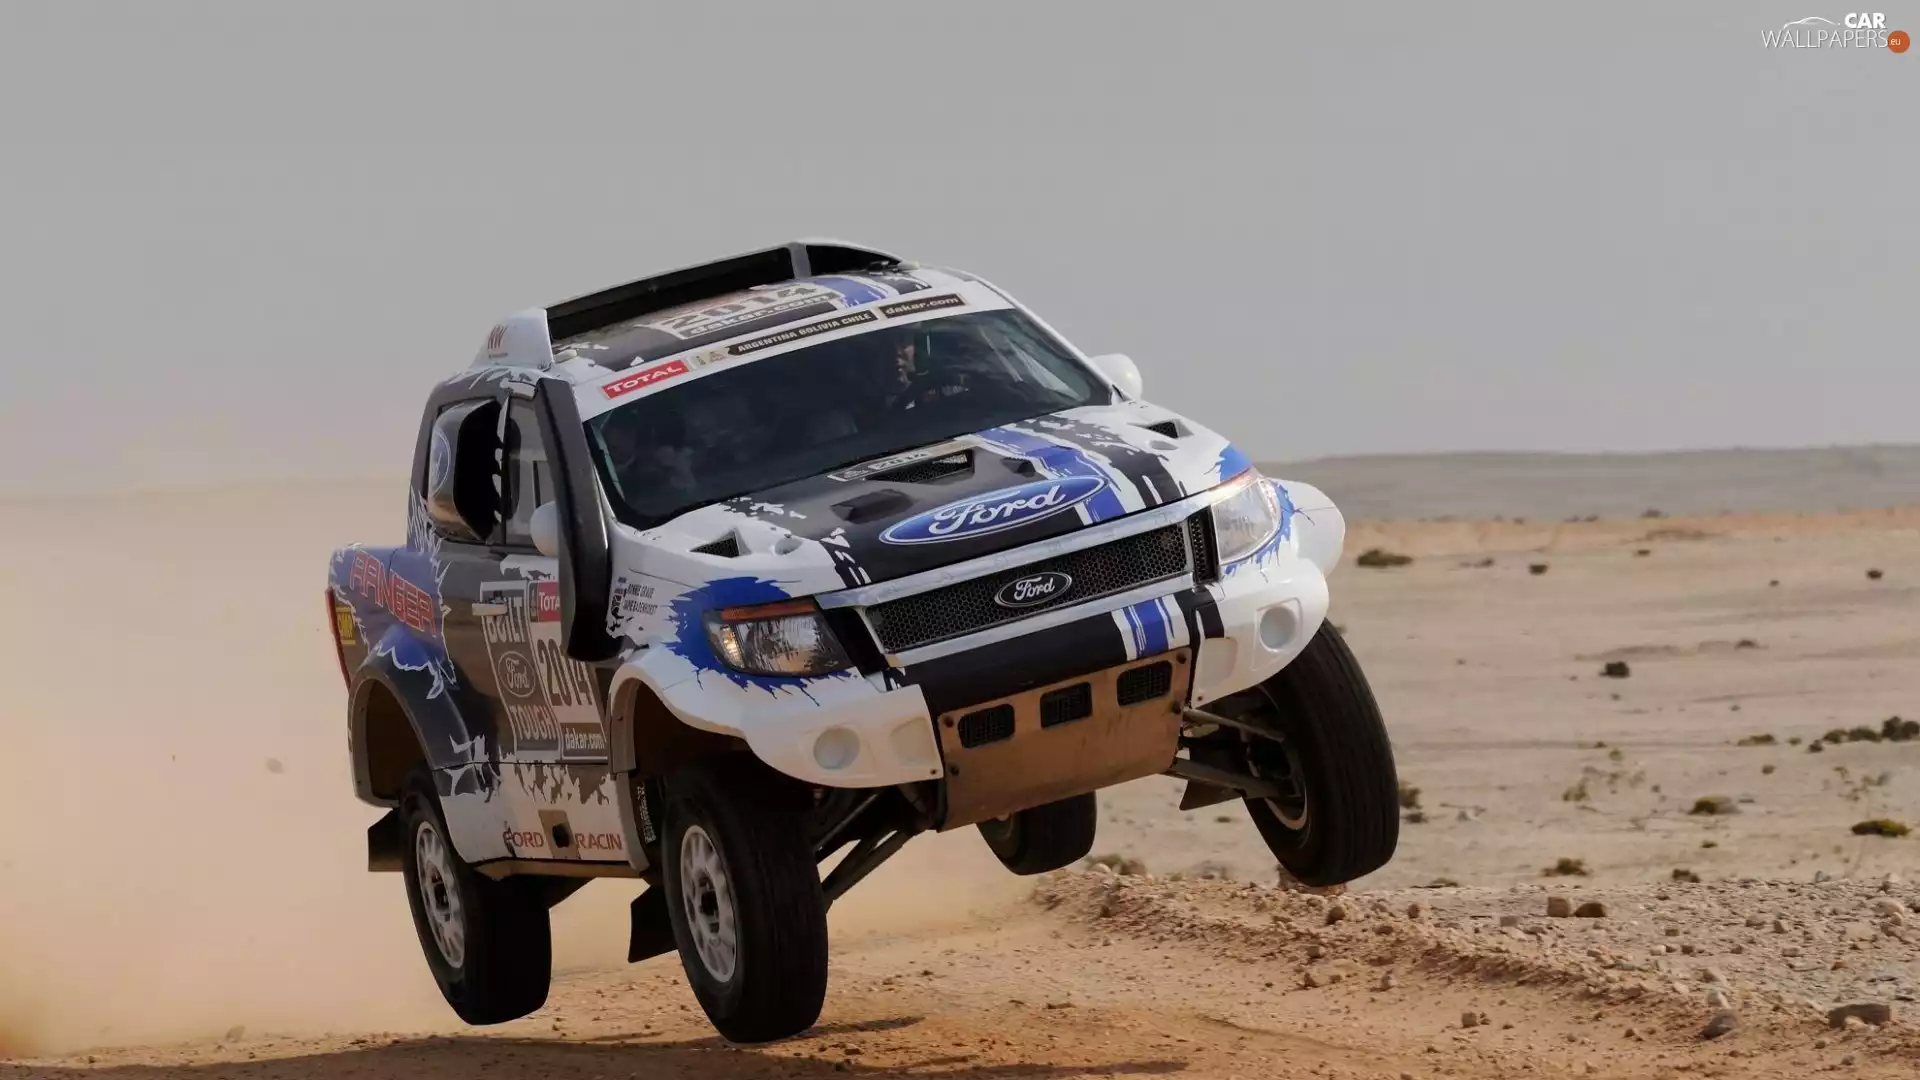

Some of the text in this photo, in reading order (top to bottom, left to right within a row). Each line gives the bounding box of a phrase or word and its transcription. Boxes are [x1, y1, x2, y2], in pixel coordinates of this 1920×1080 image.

[690, 293, 830, 335] dakar.com
[885, 297, 960, 315] dakar.com
[737, 312, 873, 353] ARGENTINA BOLIVIA CHILE
[607, 365, 682, 394] TOTAL
[928, 485, 1067, 535] Ford
[350, 549, 437, 639] RANGER
[1013, 576, 1056, 601] Ford
[485, 596, 526, 643] BUILT
[505, 656, 531, 691] Ford
[537, 638, 592, 707] 2014
[511, 703, 557, 741] TOUGH
[565, 727, 605, 750] dakar.com
[503, 831, 622, 850] FORD RACIN
